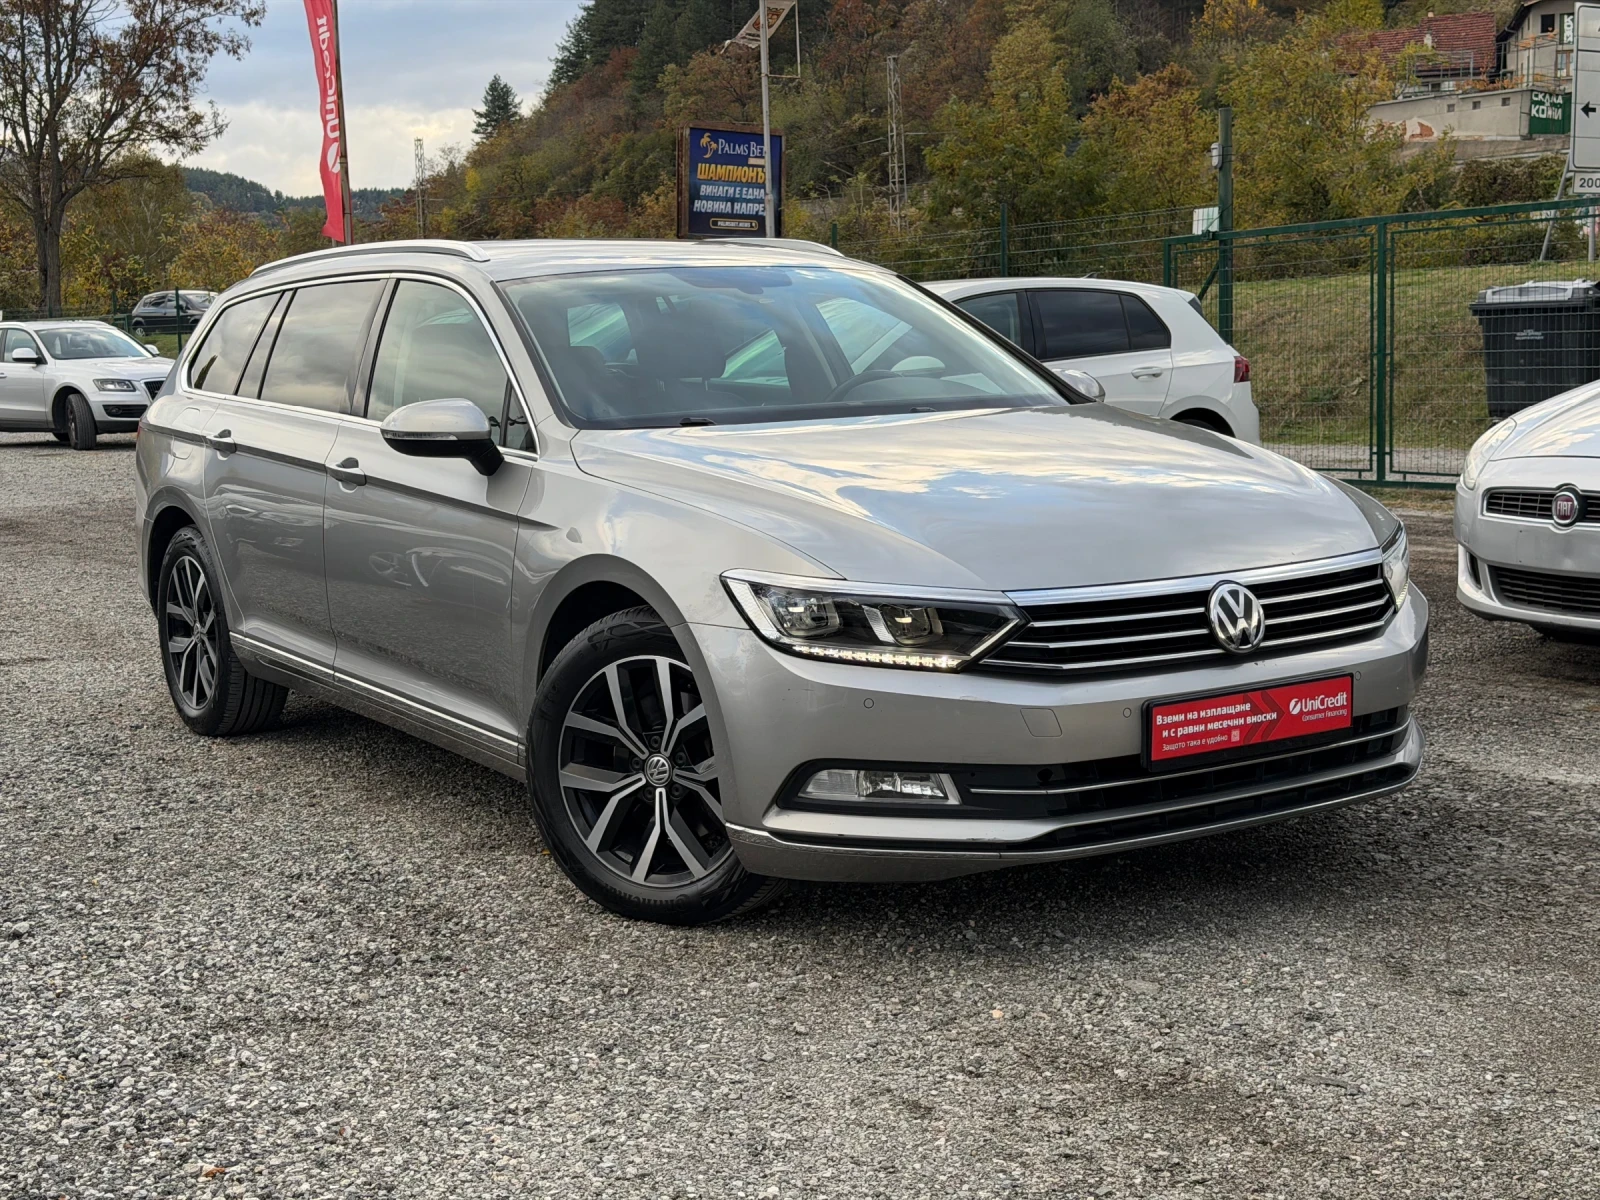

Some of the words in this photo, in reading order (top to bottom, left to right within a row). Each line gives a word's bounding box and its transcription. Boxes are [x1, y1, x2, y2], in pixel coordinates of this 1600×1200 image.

[697, 163, 766, 184] ШАМПИОНЪ
[700, 184, 735, 198] ВИНАГИ
[735, 187, 741, 198] Е
[742, 187, 765, 199] ЕДНА
[693, 199, 732, 213] НОВИНА
[733, 202, 766, 216] НАПРЕ
[1556, 501, 1573, 516] FIAT
[1302, 691, 1347, 712] UniCredit
[1156, 713, 1185, 725] Вземи
[1187, 711, 1198, 720] на
[1200, 703, 1251, 718] изплащане
[1302, 712, 1325, 722] Consumer
[1325, 708, 1348, 718] Financing
[1162, 730, 1168, 738] и
[1170, 728, 1176, 737] с
[1177, 723, 1205, 738] равни
[1207, 717, 1245, 730] месечни
[1246, 712, 1277, 724] вноски
[1162, 742, 1186, 751] Защото
[1187, 739, 1201, 748] така
[1207, 734, 1229, 746] удобно
